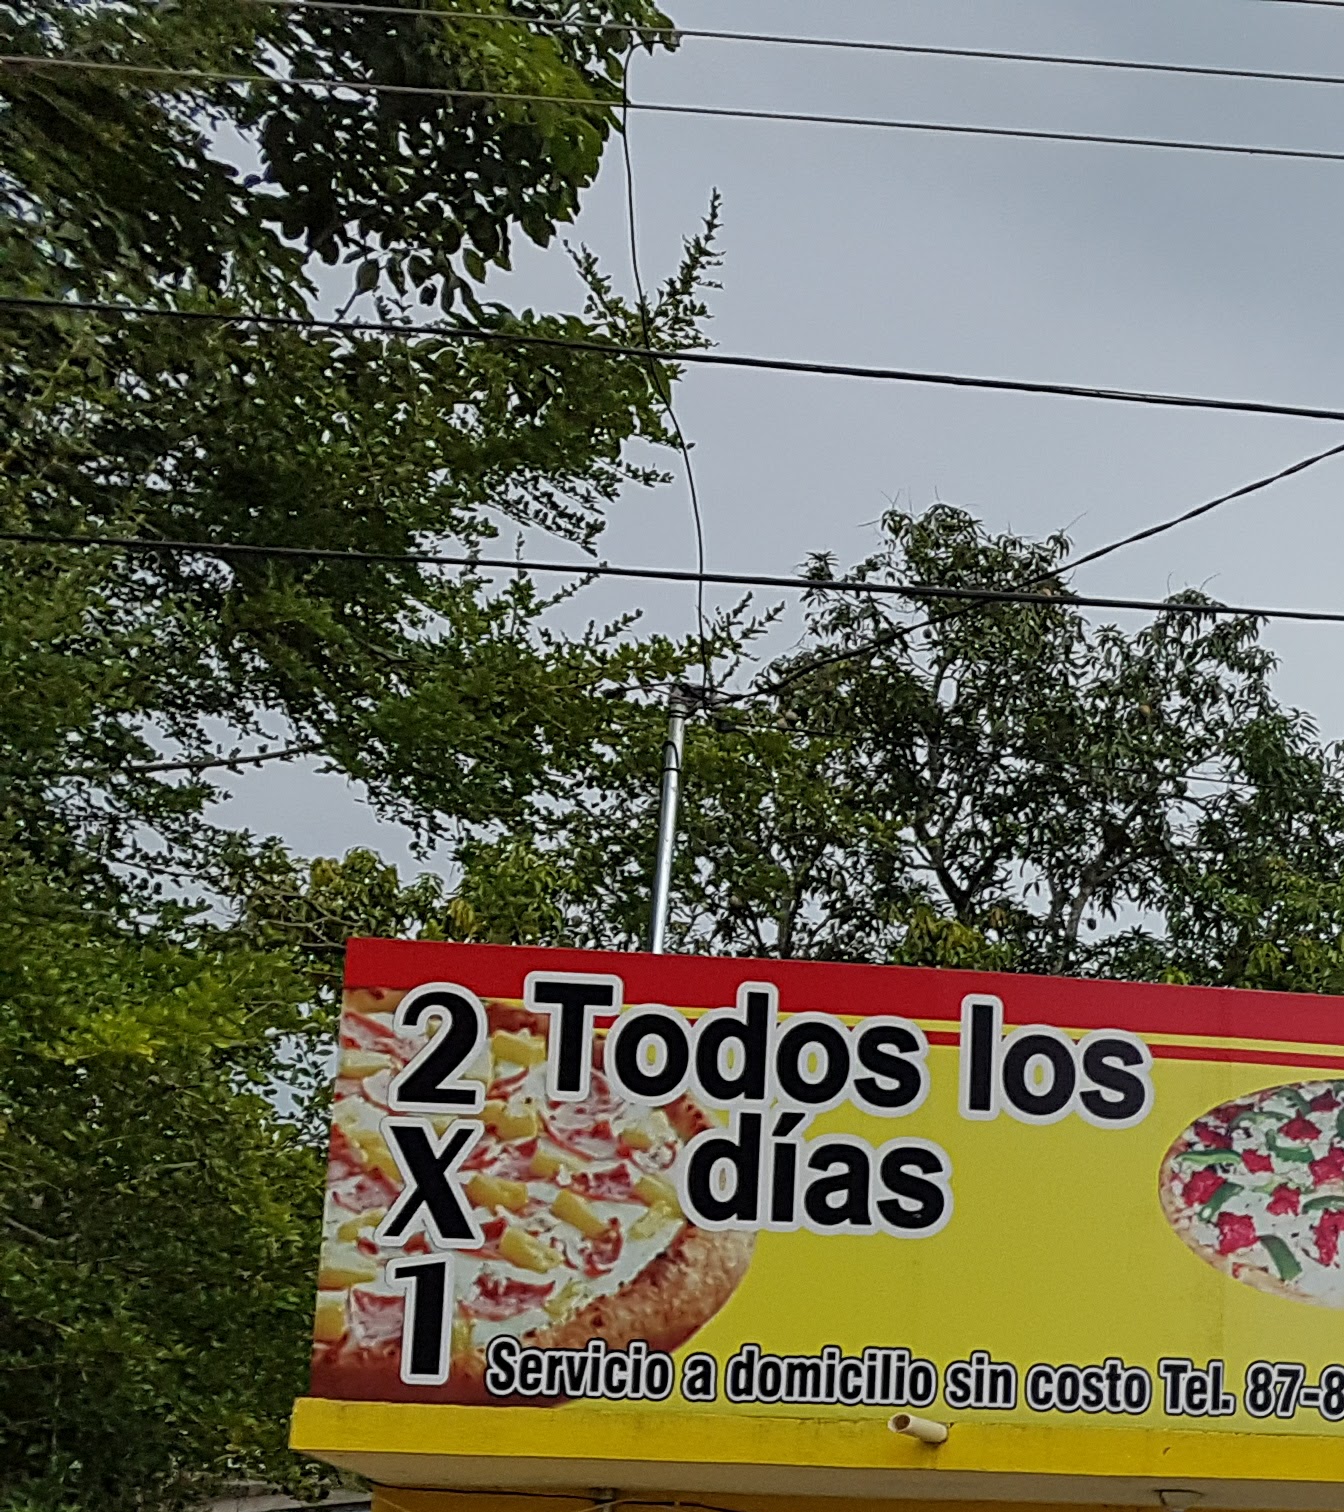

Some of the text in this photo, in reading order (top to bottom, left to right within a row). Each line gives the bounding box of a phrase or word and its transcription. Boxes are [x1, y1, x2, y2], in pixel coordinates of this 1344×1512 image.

[529, 977, 1149, 1123] Todos los
[379, 987, 485, 1380] 2 X 1
[683, 1109, 950, 1234] días
[487, 1338, 672, 1399] Servicio
[682, 1356, 714, 1399] a
[729, 1345, 933, 1406] domicilio
[945, 1352, 1016, 1408] sin
[1029, 1358, 1152, 1413] costo
[1161, 1360, 1235, 1418] Tel.
